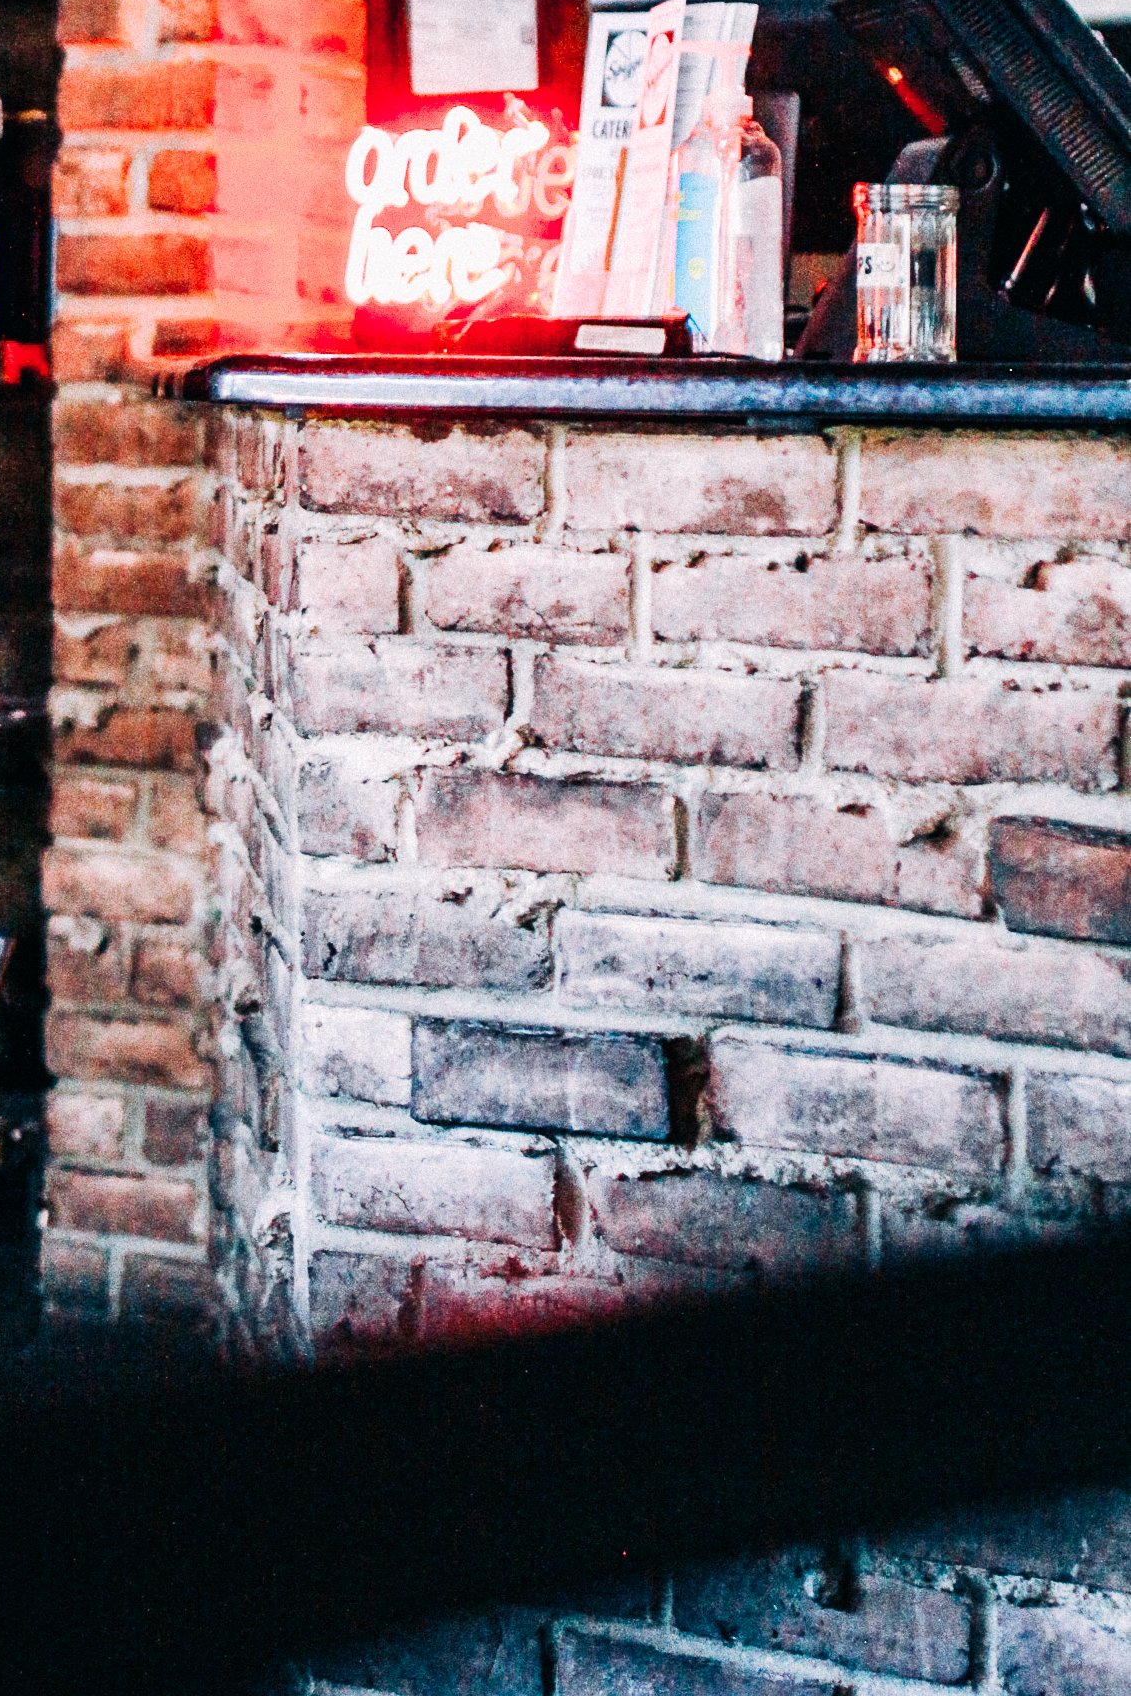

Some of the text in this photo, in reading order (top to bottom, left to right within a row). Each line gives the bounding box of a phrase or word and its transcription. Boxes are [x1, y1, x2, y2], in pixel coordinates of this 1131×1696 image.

[345, 105, 550, 206] order
[592, 119, 632, 140] CATER
[345, 204, 512, 305] here
[857, 255, 873, 275] PS
